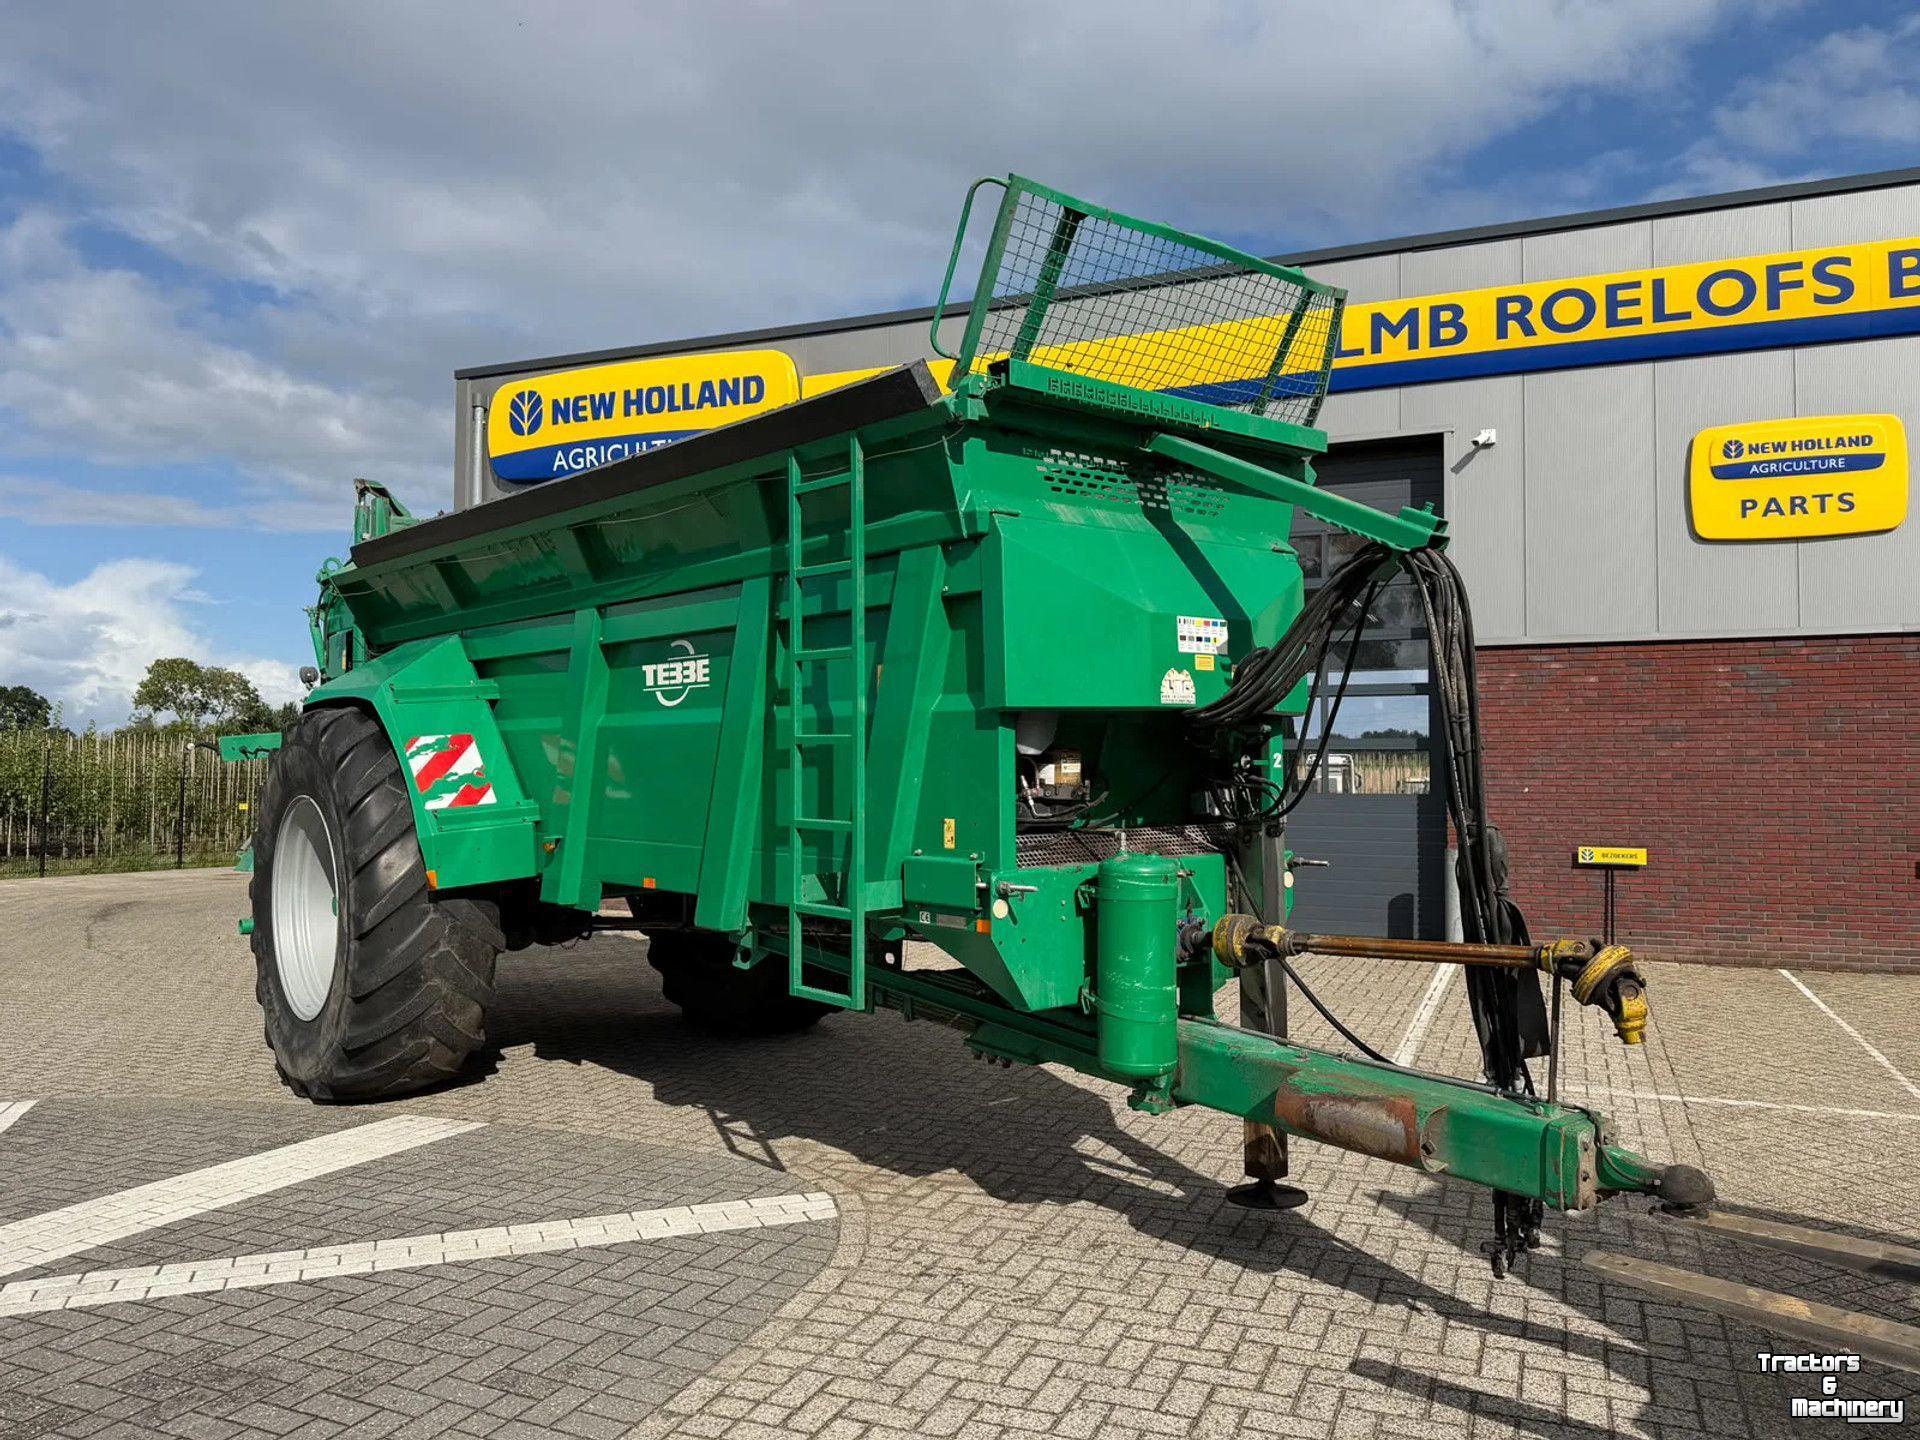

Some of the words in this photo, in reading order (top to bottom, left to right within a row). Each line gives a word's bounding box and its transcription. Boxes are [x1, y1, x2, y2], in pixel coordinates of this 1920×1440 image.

[1334, 303, 1468, 358] LMB
[1496, 256, 1855, 340] ROELOFS
[552, 391, 616, 425] NEW
[623, 375, 765, 417] HOLLAND
[1748, 440, 1787, 455] NEW
[1791, 434, 1873, 451] HOLLAND
[1749, 457, 1846, 474] AGRICULTURE
[1740, 492, 1856, 519] PARTS
[642, 659, 710, 686] TEBBE
[1273, 752, 1282, 768] 2
